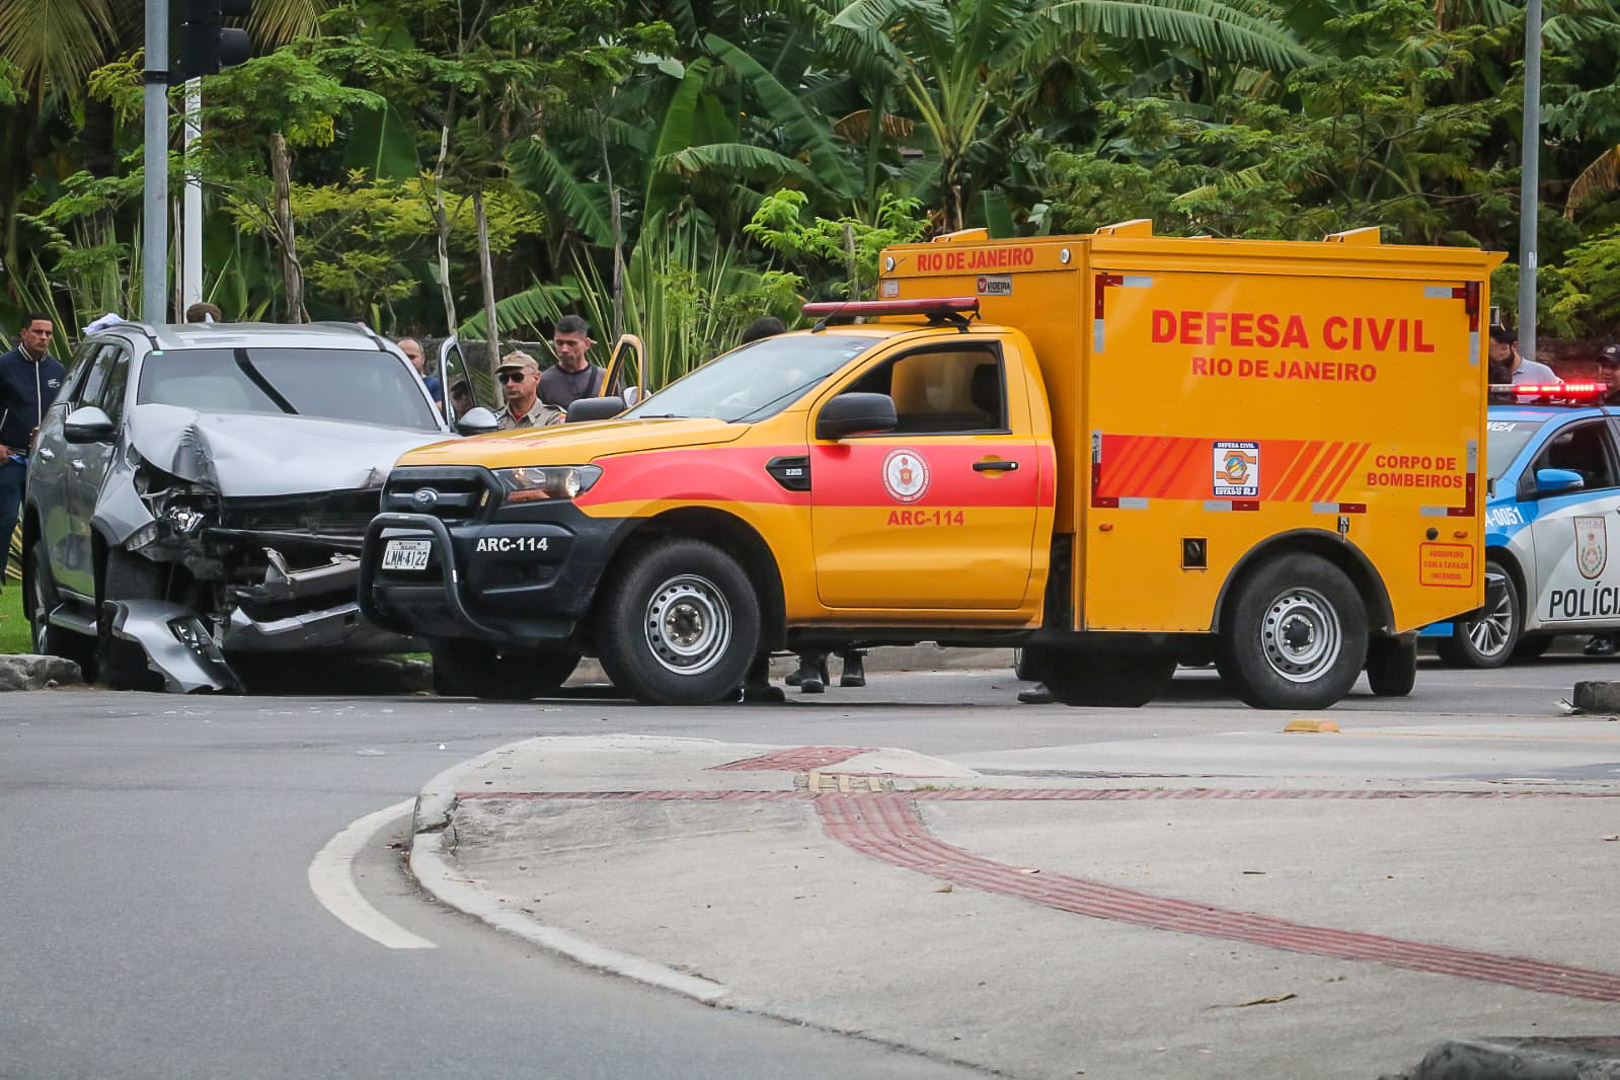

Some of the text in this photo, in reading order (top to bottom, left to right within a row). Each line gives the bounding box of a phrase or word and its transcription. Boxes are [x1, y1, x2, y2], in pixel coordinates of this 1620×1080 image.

[917, 247, 1034, 271] RIO DE JANEIRO
[987, 281, 1010, 290] VIDEIRA
[1151, 309, 1435, 353] DEFESA CIVIL
[1192, 357, 1377, 382] RIO DE JANEIRO
[1375, 455, 1456, 471] CORPO DE
[1367, 472, 1463, 488] BOMBEIROS
[1243, 487, 1256, 495] RJ
[887, 510, 965, 526] ARC-114
[476, 537, 549, 552] ARC-114
[1549, 581, 1620, 618] POLÍCI
